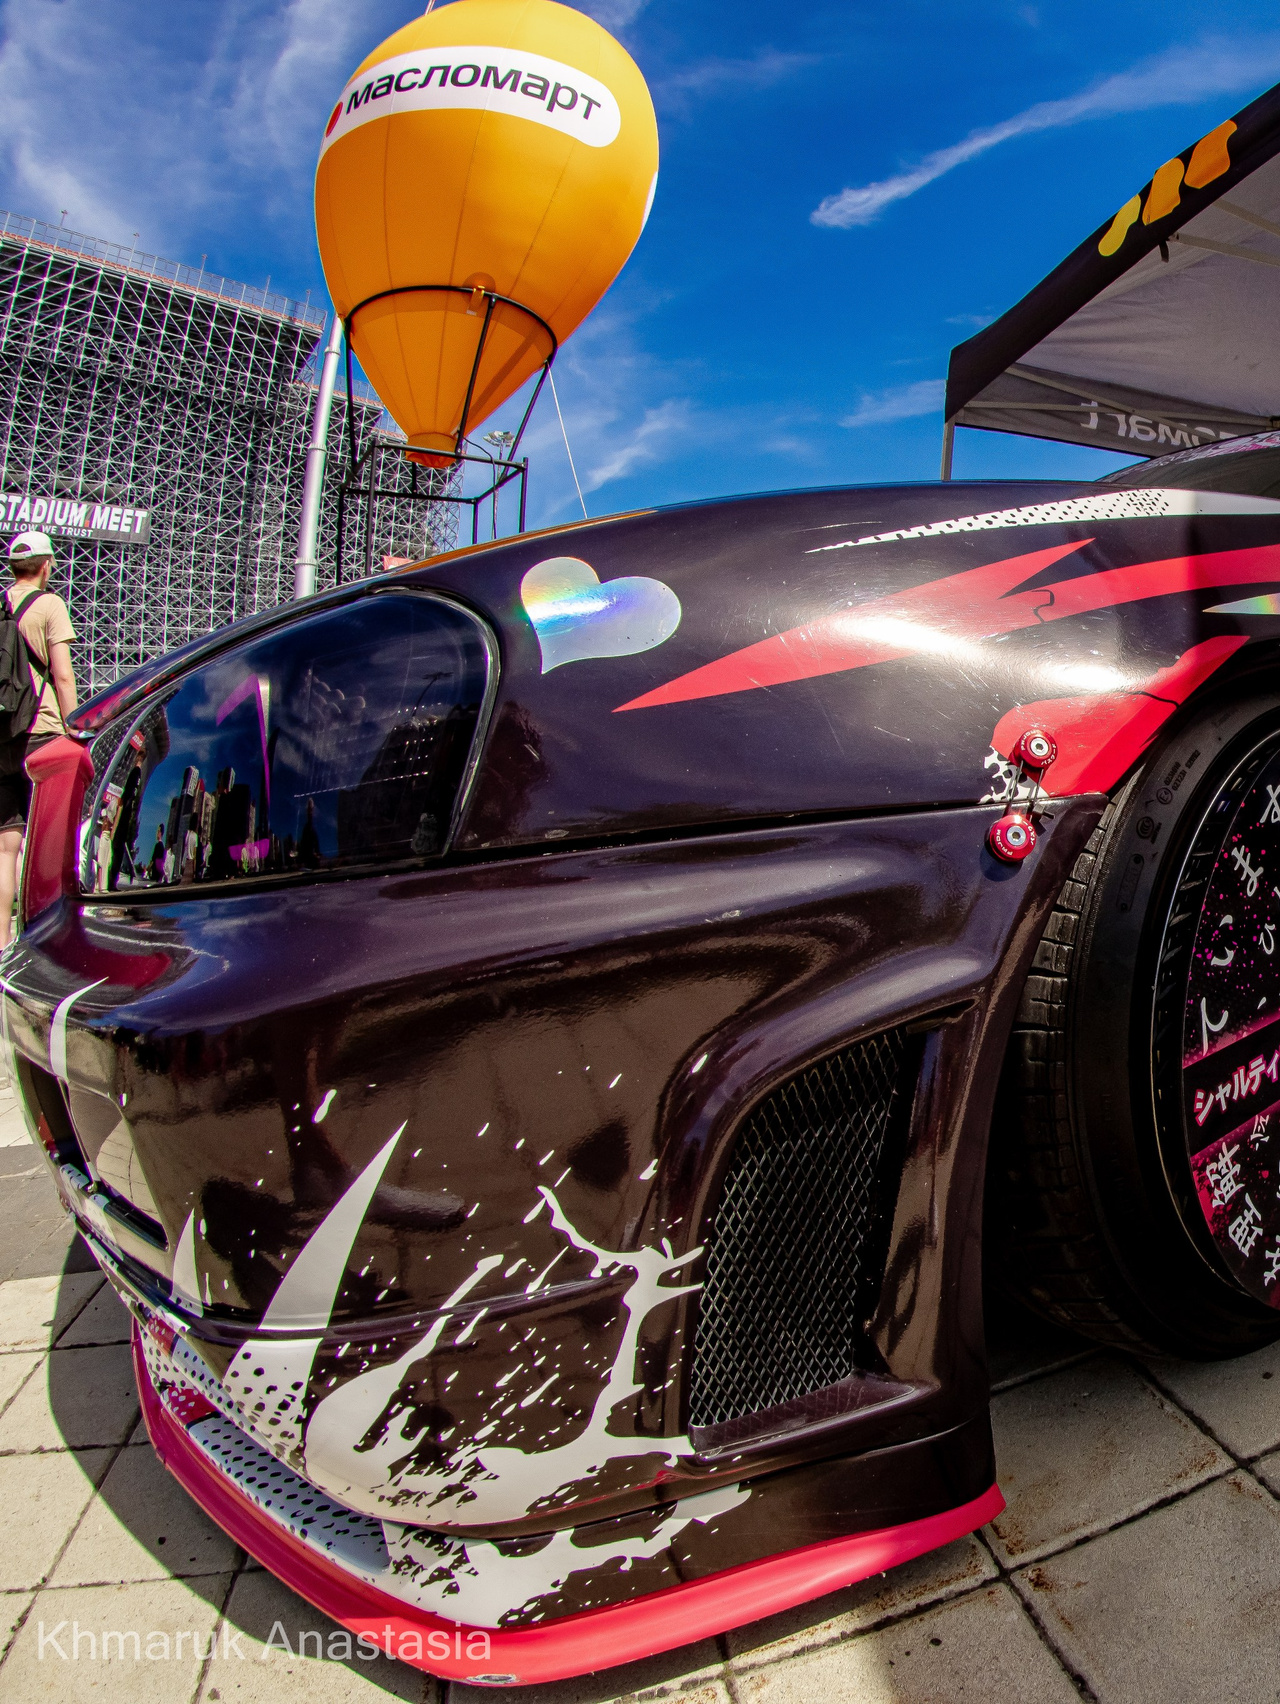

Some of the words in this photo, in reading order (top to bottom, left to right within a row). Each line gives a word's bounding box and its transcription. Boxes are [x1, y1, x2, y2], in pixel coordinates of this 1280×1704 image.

[346, 64, 601, 120] масломарт
[42, 525, 57, 535] WE
[60, 527, 93, 538] TRUST
